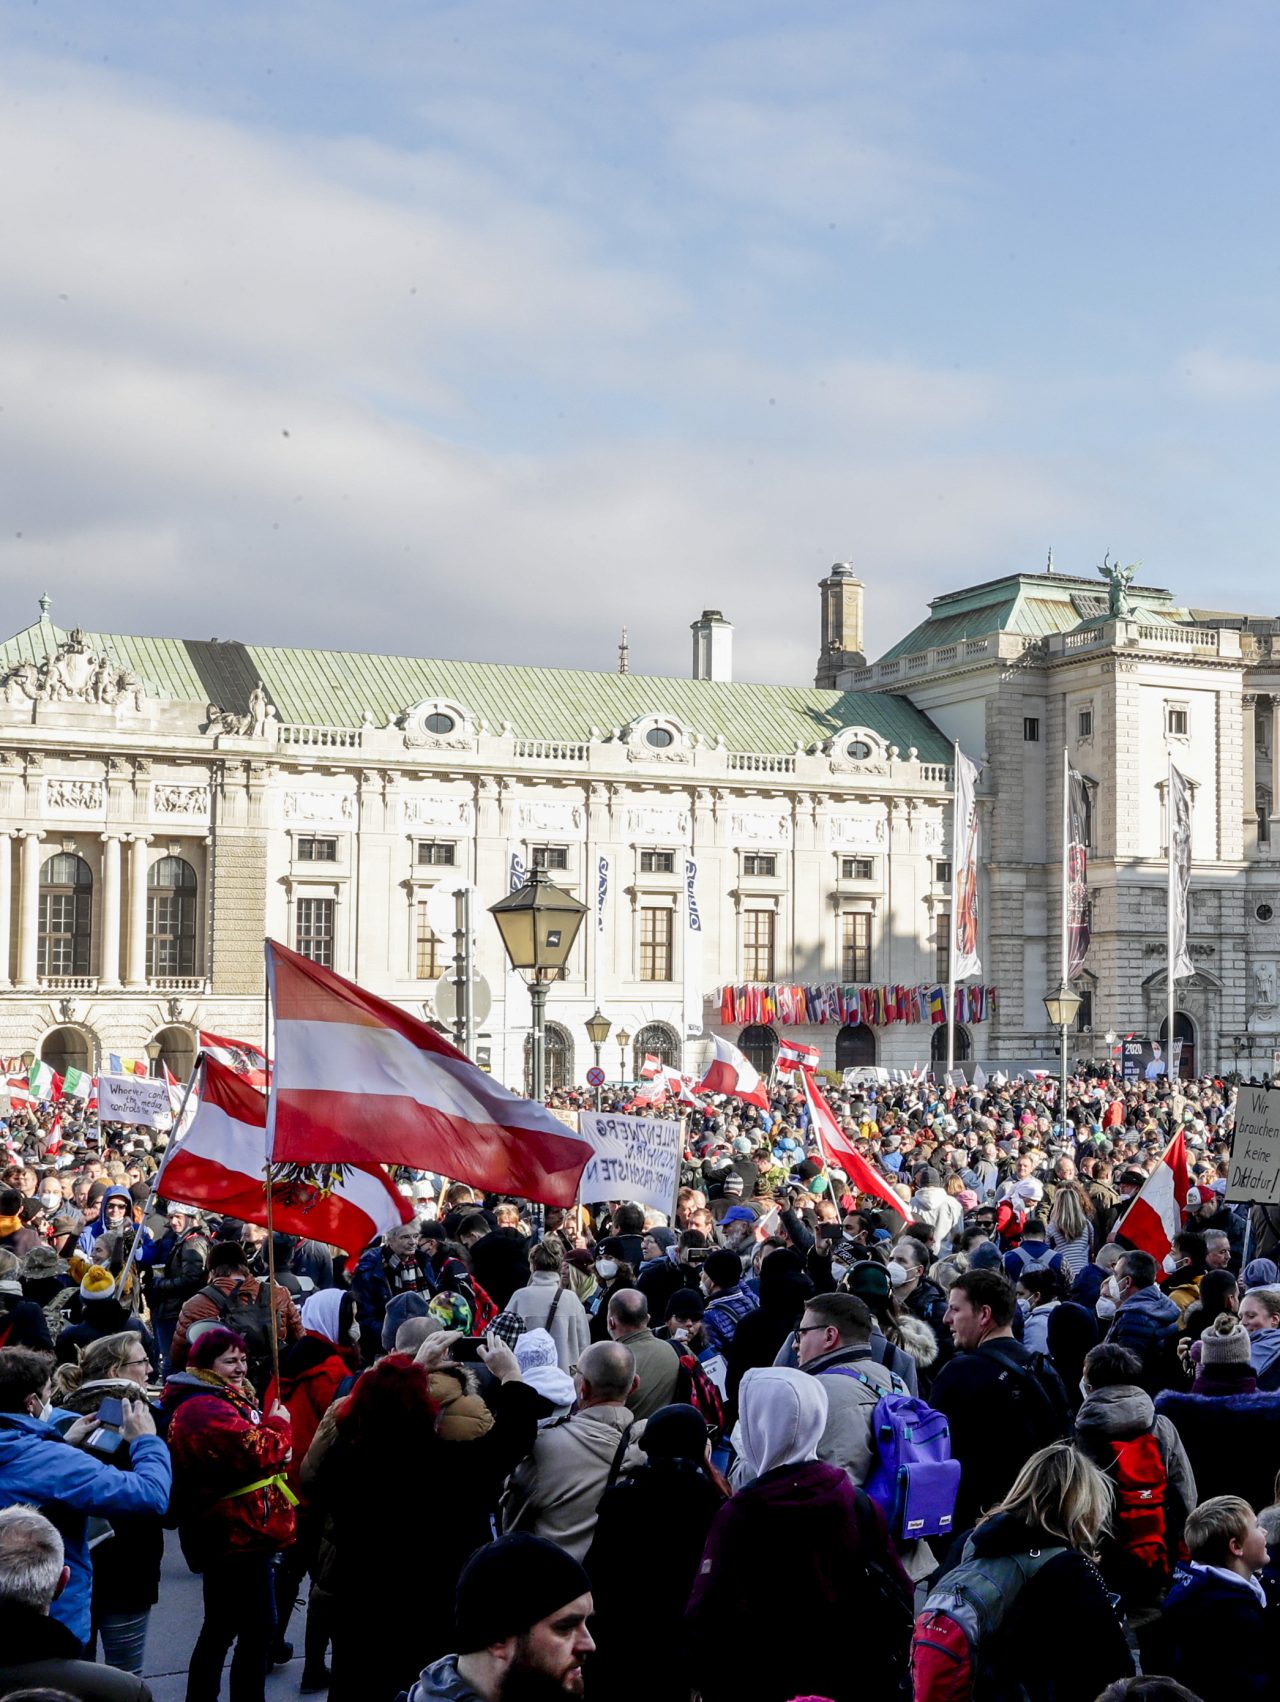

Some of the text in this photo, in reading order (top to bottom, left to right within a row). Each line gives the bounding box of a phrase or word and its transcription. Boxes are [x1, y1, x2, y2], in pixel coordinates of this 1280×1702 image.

[1125, 1043, 1143, 1055] 2020
[110, 1083, 143, 1097] Whoever
[126, 1096, 136, 1104] the
[1252, 1092, 1270, 1115] Wir
[1238, 1115, 1280, 1139] brauchen
[1244, 1140, 1271, 1162] keine
